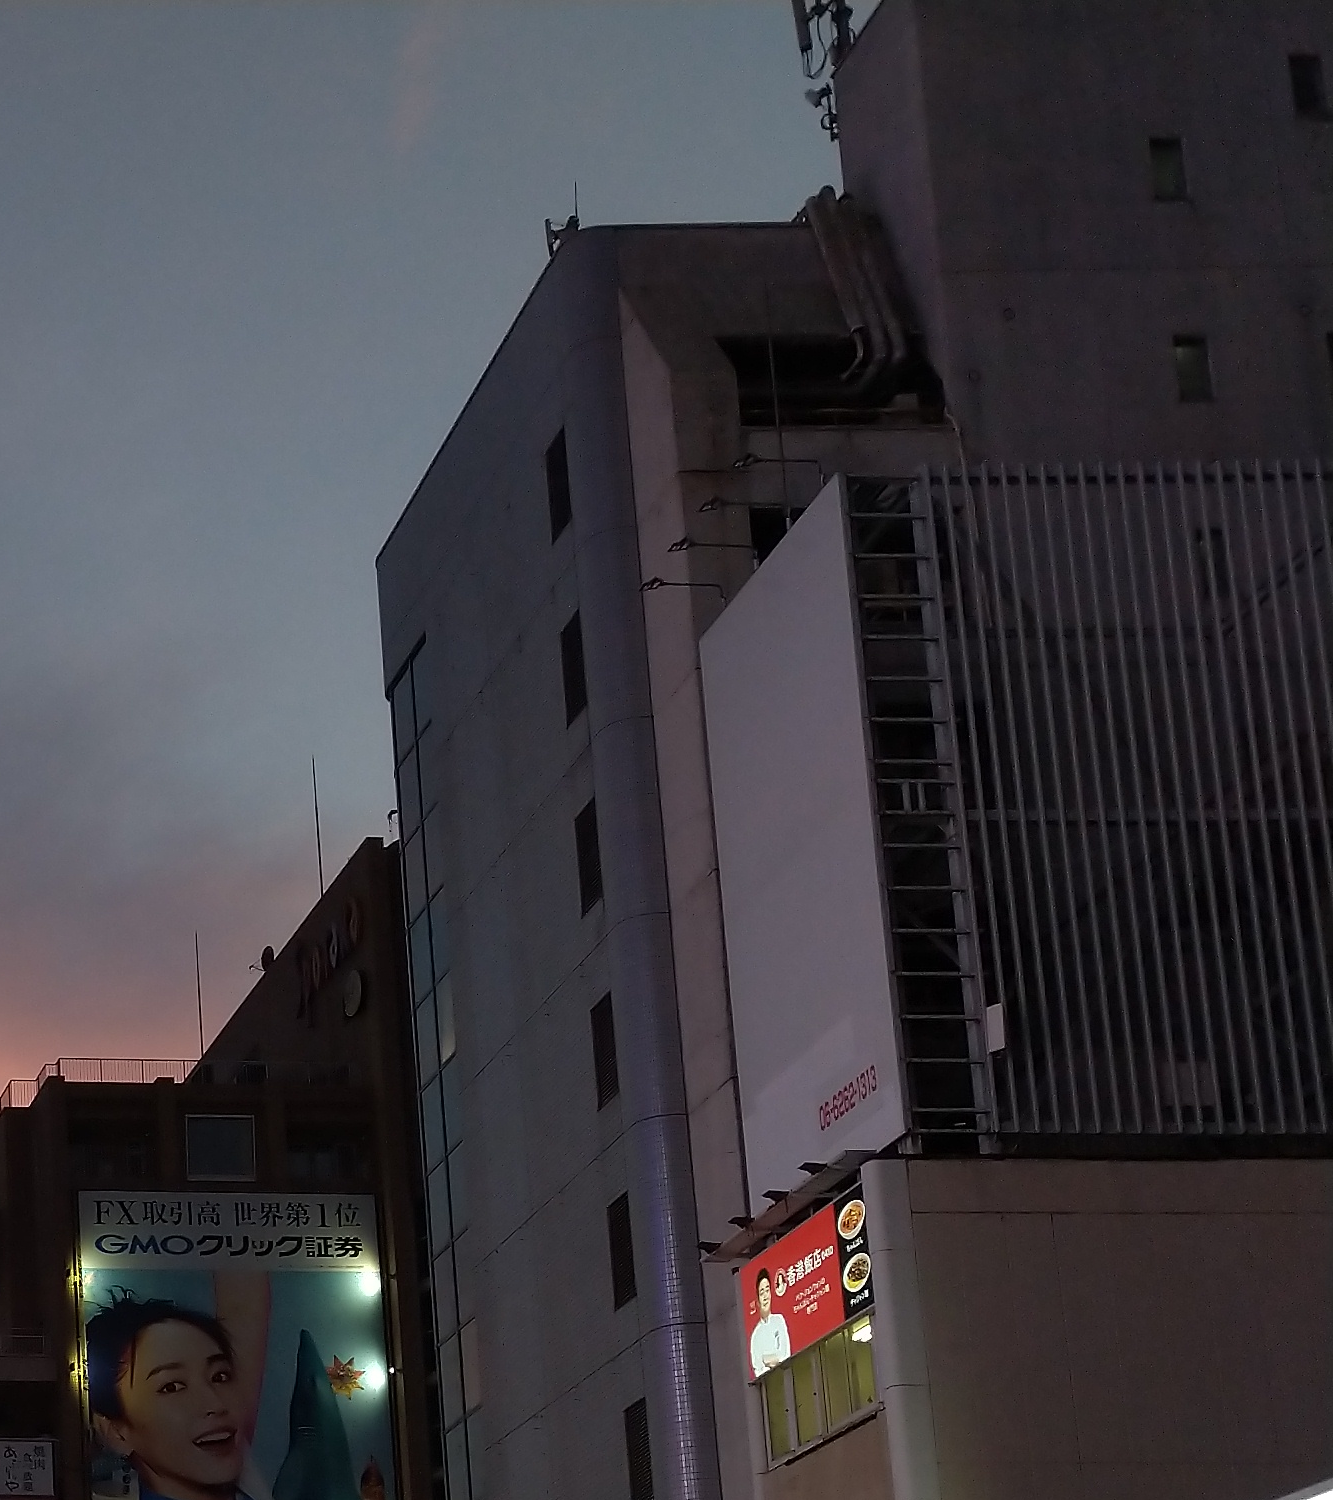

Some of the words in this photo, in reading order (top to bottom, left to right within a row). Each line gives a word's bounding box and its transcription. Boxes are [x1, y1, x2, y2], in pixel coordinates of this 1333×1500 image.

[818, 1064, 879, 1132] 06-6262-1313
[94, 1233, 364, 1258] GMOクリック証券
